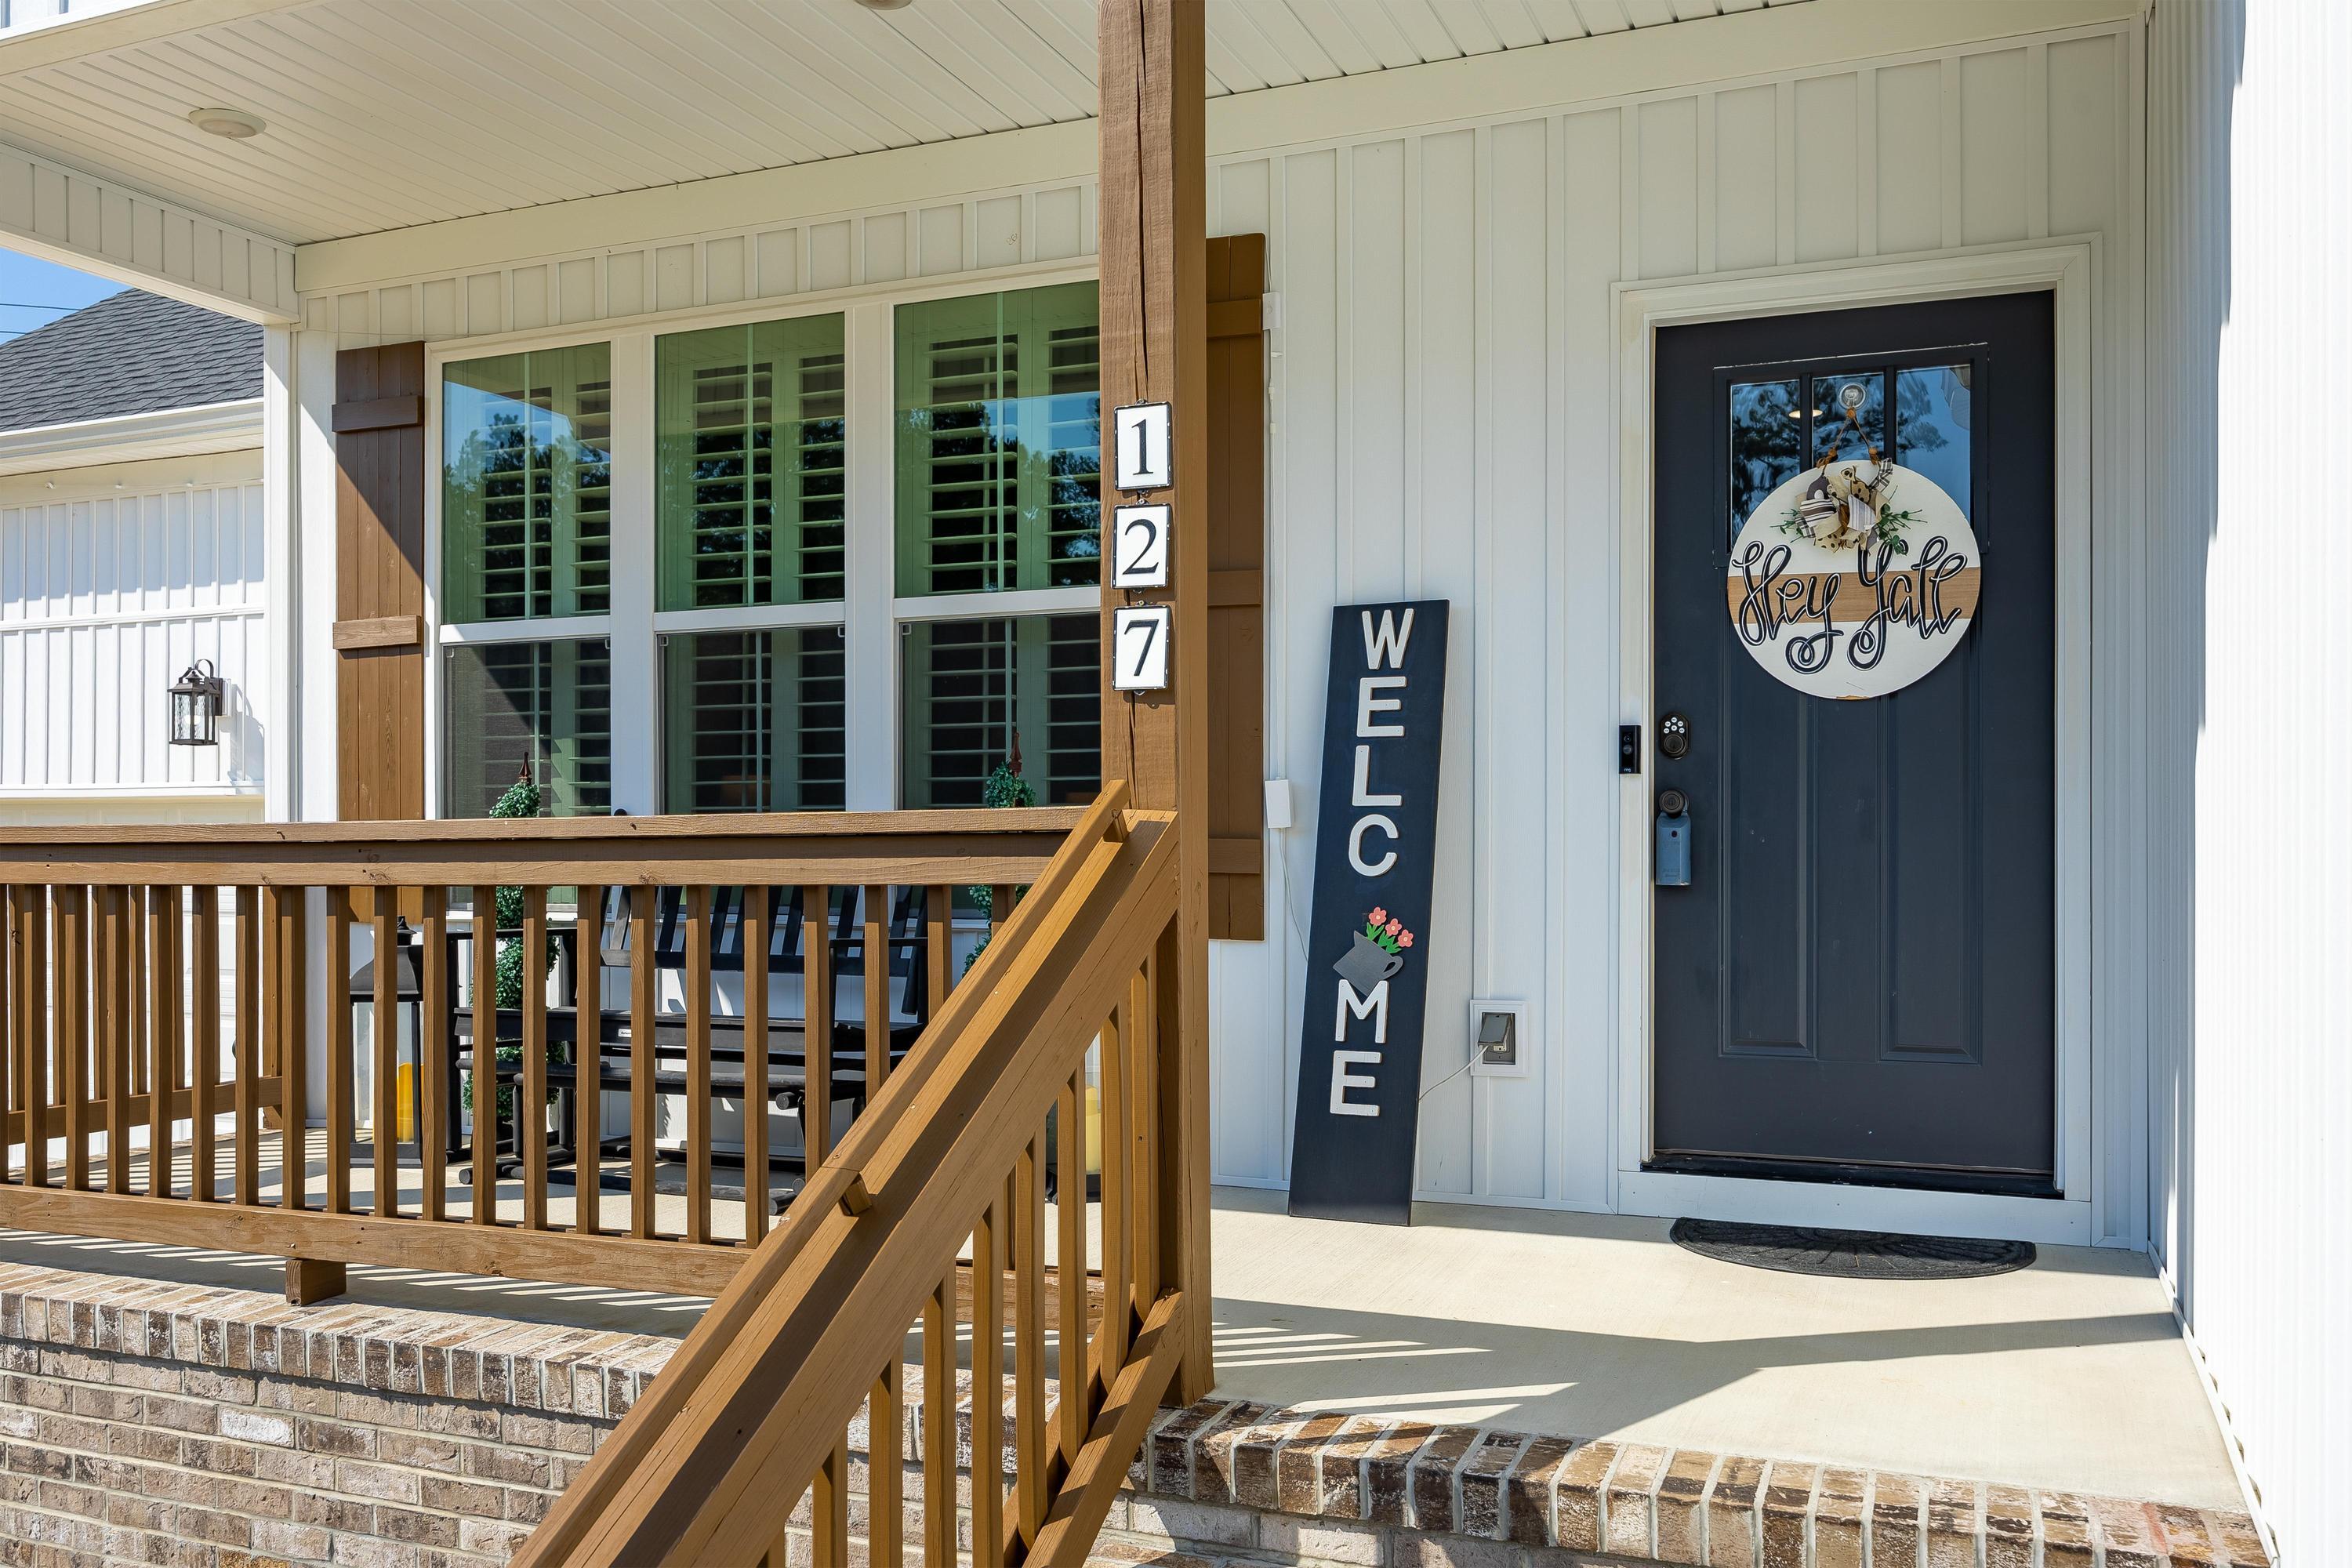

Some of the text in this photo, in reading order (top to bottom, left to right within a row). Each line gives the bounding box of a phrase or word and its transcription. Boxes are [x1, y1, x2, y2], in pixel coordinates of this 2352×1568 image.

[1123, 419, 1160, 677] 127
[1732, 540, 1844, 674] Hey
[1330, 608, 1414, 1116] WELCME
